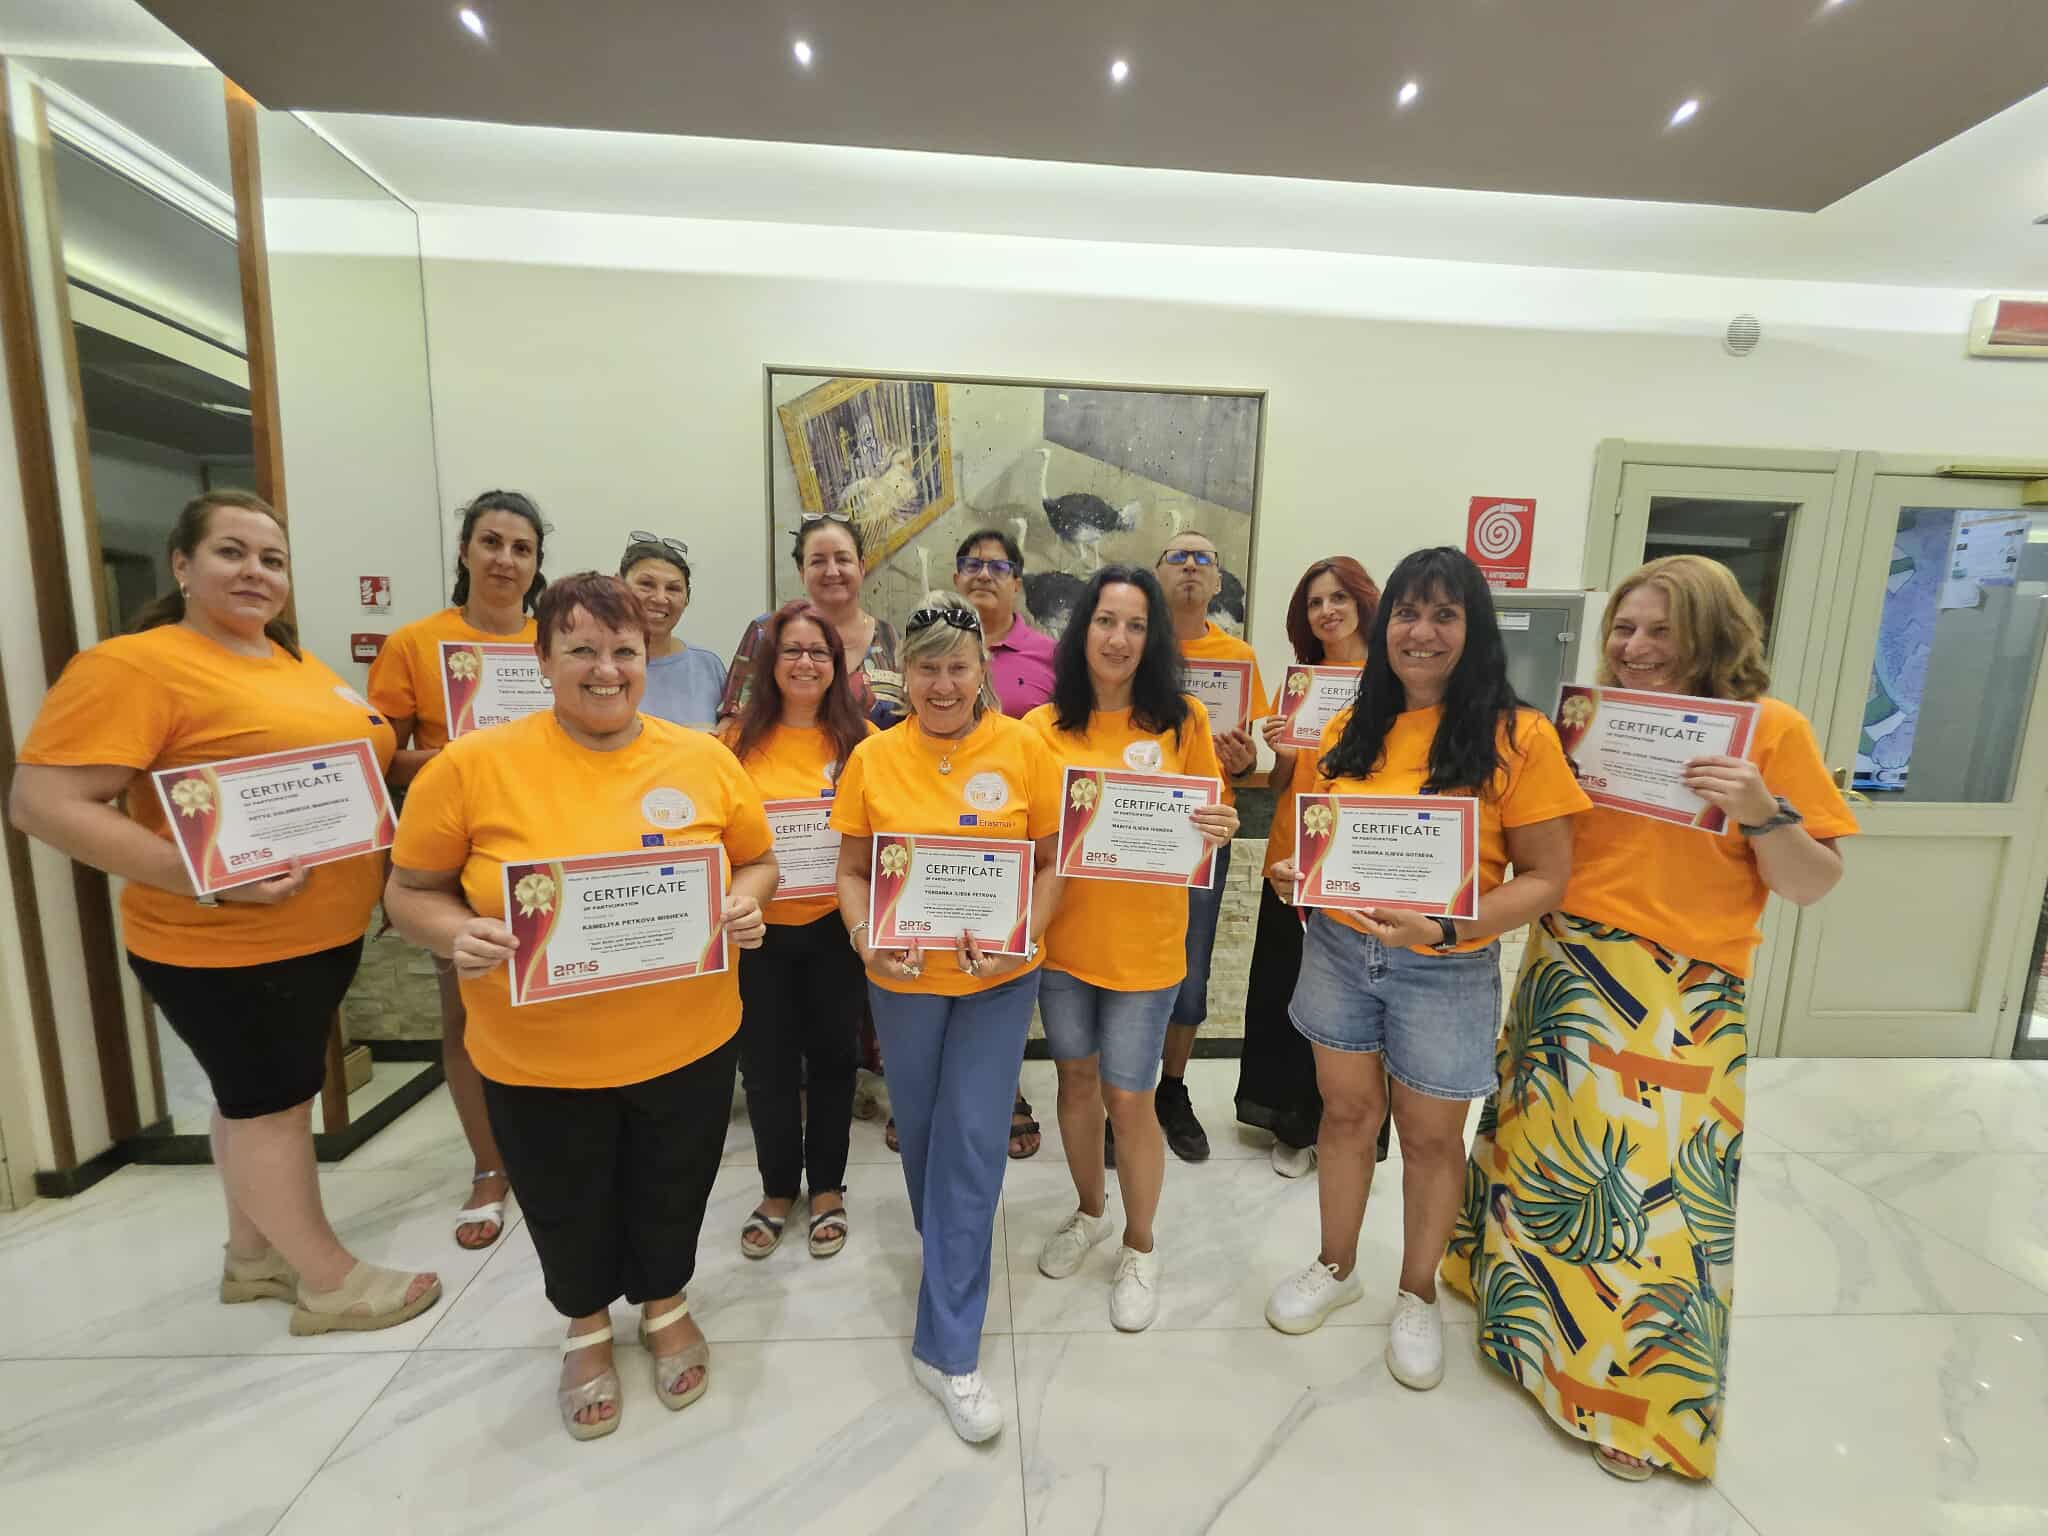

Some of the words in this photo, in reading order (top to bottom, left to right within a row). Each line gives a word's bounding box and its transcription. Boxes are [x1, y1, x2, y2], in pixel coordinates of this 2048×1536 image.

[1608, 719, 1707, 743] CERTIFICATE
[240, 772, 345, 800] CERTIFICATE
[1114, 798, 1192, 814] CERTIFICATE
[1352, 823, 1441, 837] CERTIFICATE
[926, 863, 1003, 878] CERTIFICATE
[583, 880, 688, 903] CERTIFICATE
